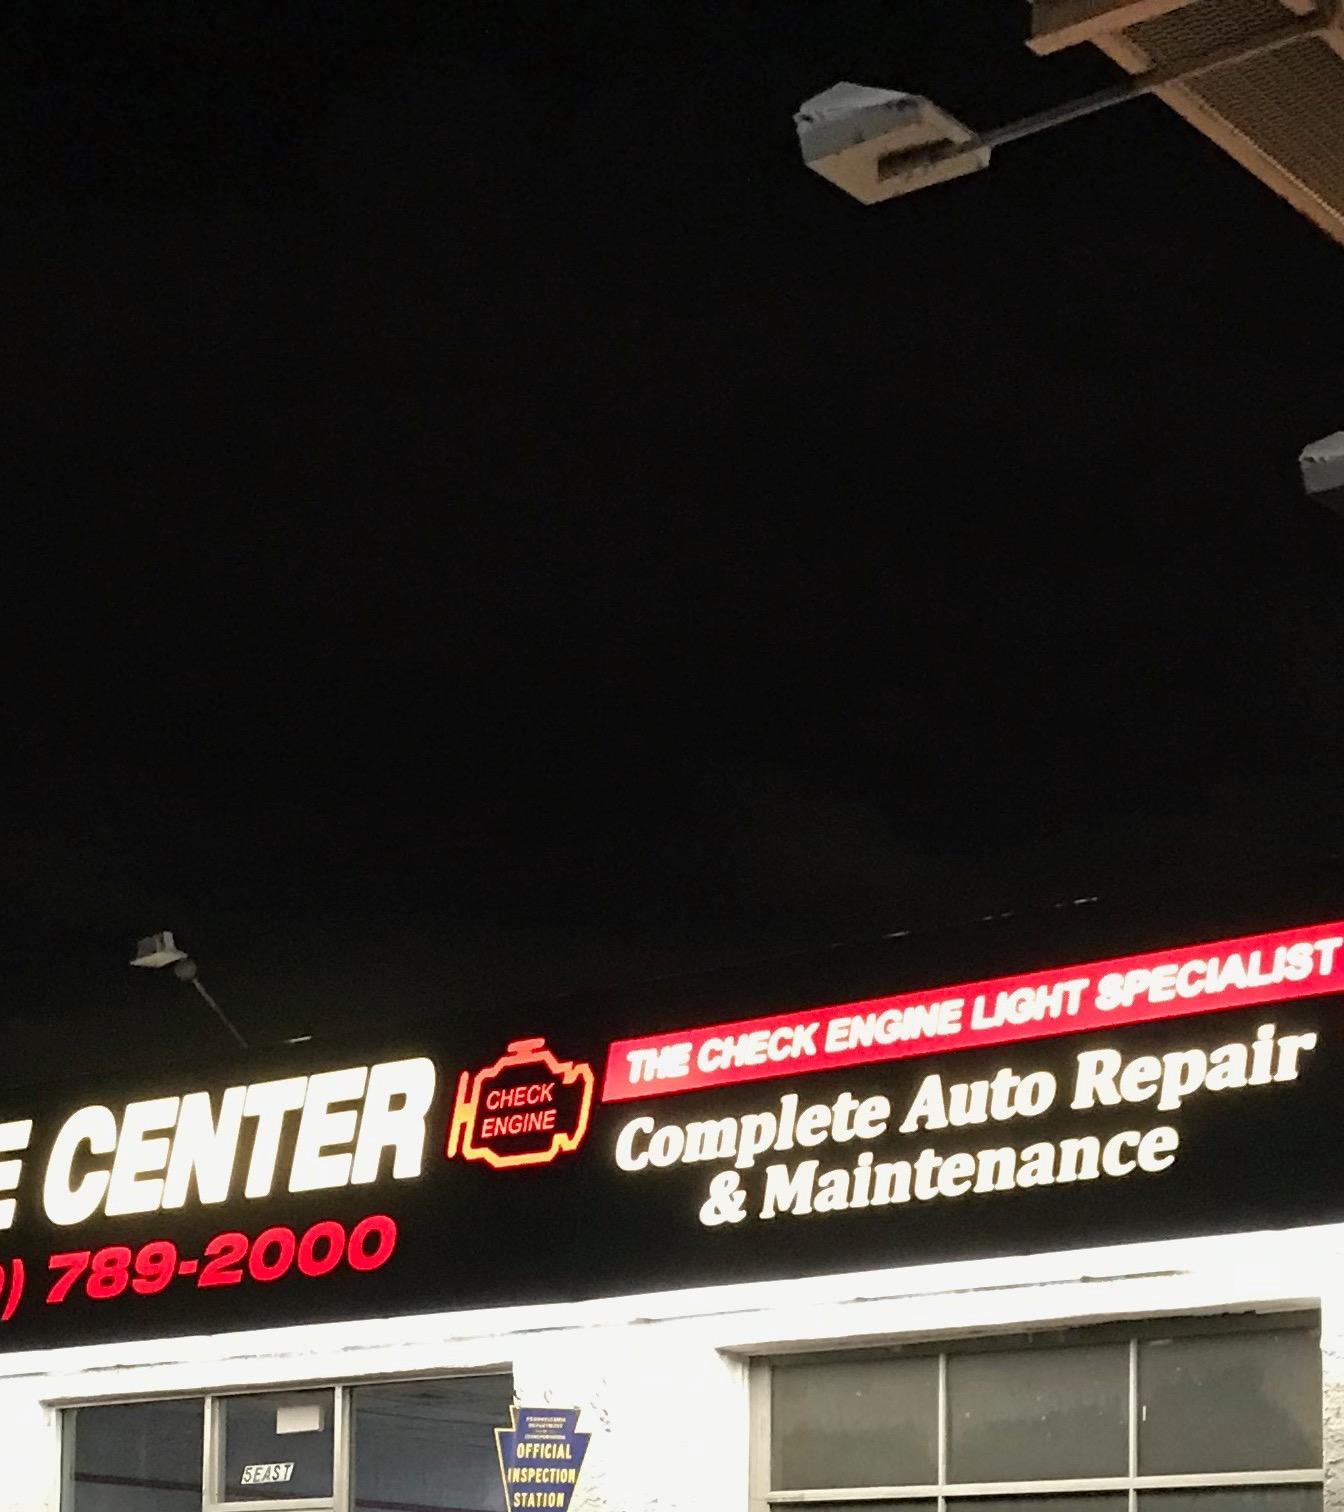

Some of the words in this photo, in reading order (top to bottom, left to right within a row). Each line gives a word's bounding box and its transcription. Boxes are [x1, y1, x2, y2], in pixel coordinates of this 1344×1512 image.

[626, 1042, 693, 1085] THE
[696, 1021, 821, 1074] CHECK
[824, 999, 964, 1054] ENGINE
[970, 978, 1090, 1031] LIGHT
[1094, 937, 1344, 1012] SPECIALIST
[480, 1109, 557, 1139] ENGINE
[485, 1082, 555, 1110] CHECK
[615, 1091, 891, 1172] Complete
[899, 1067, 1057, 1134] Auto
[1070, 1022, 1318, 1111] Repair
[42, 1056, 437, 1226] CENTER
[699, 1169, 747, 1227] &
[758, 1125, 1180, 1220] Maintenance
[45, 1214, 399, 1303] 789-2000
[507, 1467, 576, 1484] INSPECTION
[516, 1442, 573, 1460] OFFICIAL
[513, 1491, 565, 1508] STATION
